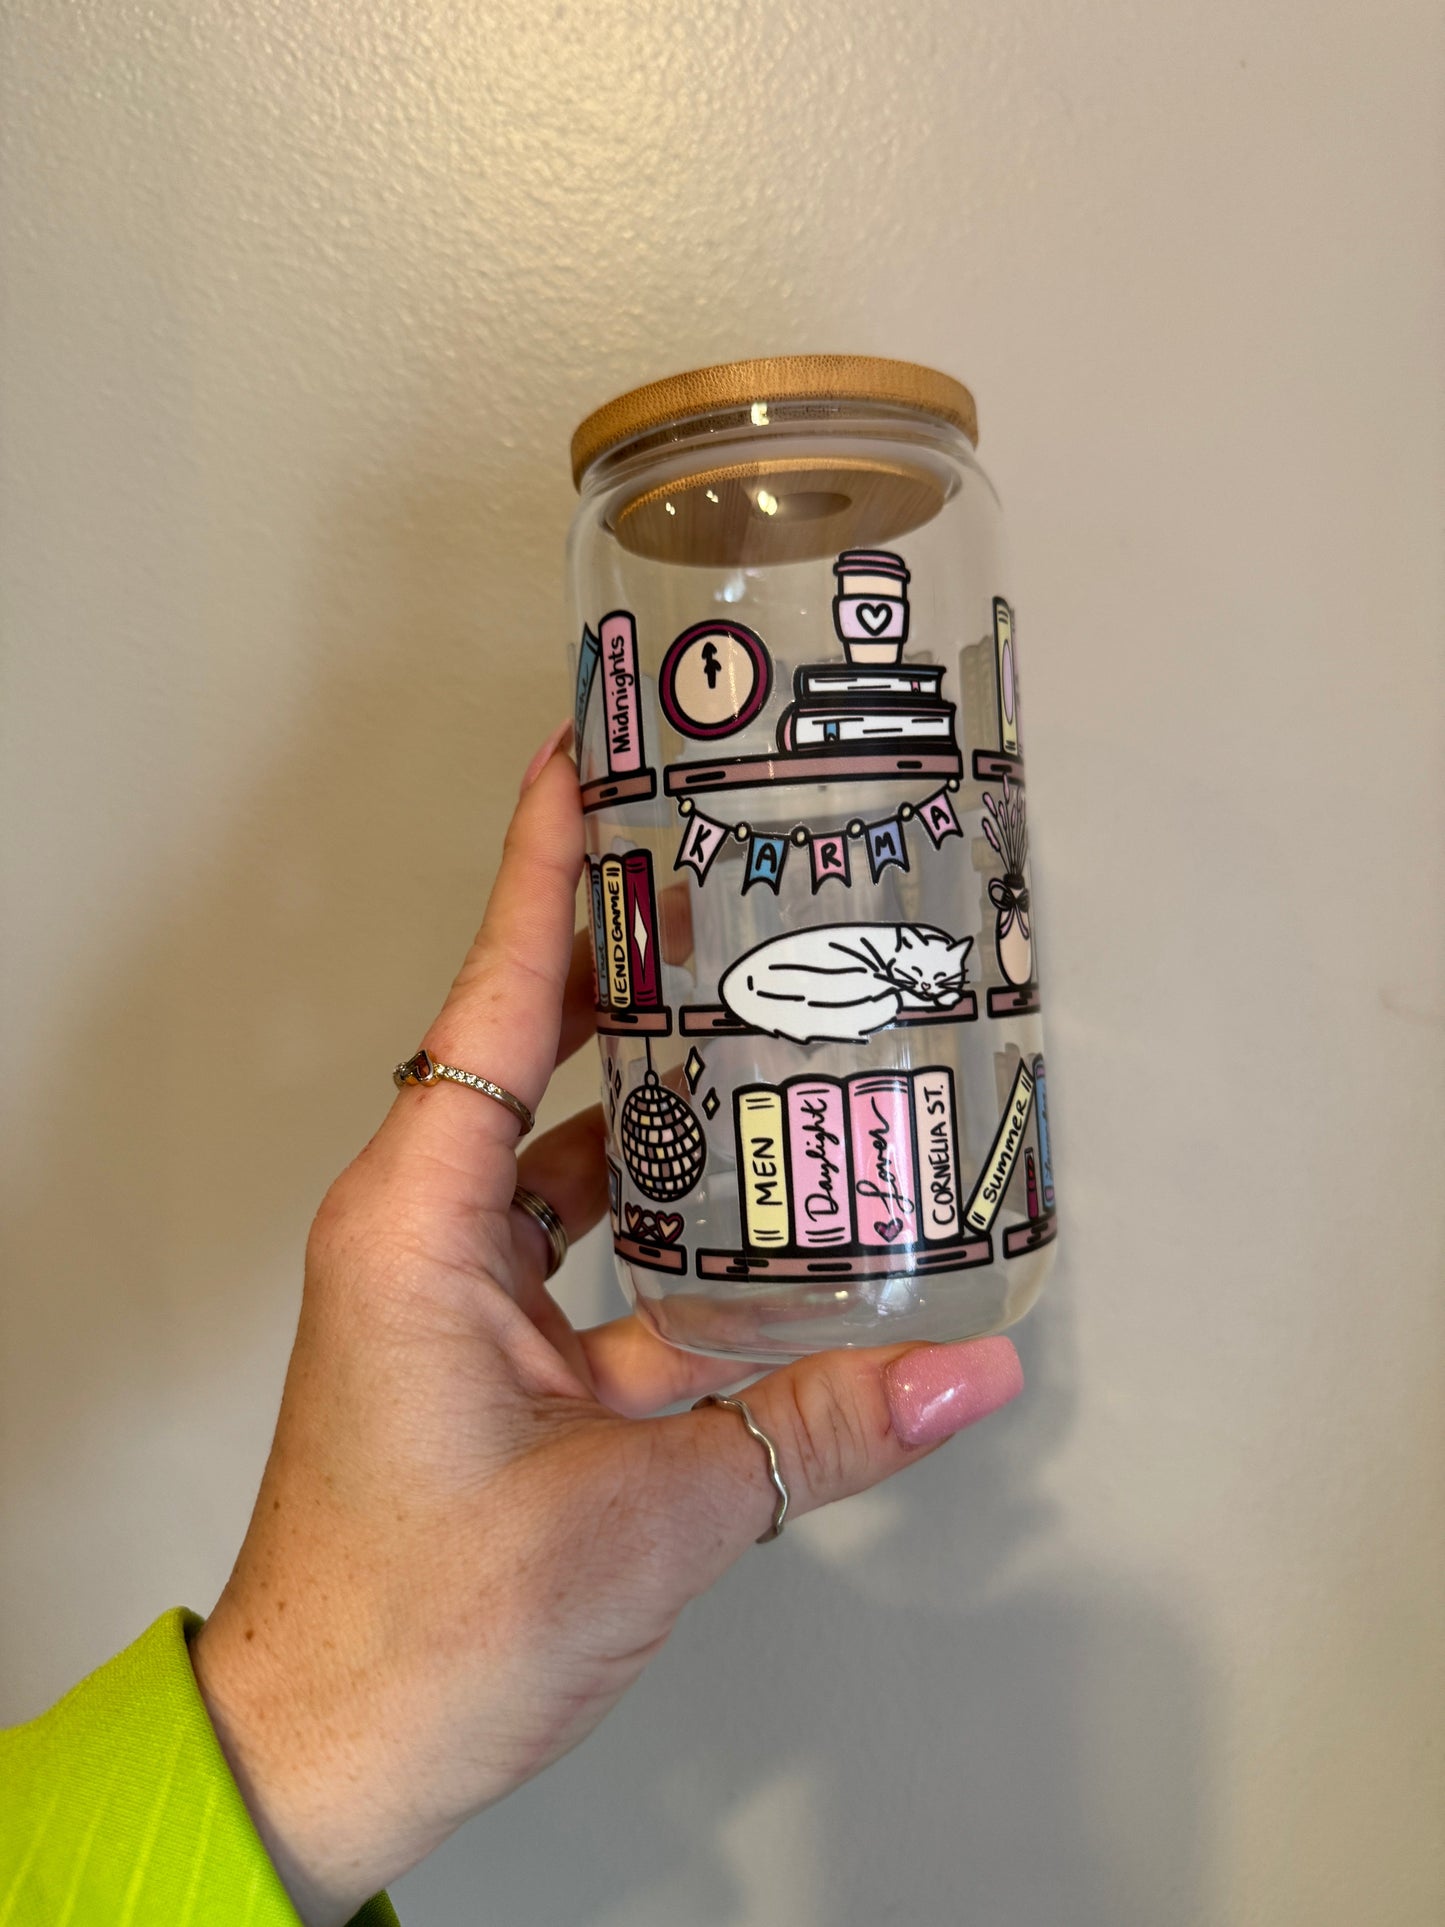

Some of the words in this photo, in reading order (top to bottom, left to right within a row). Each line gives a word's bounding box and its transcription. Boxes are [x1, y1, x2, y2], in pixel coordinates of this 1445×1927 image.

[610, 635, 634, 754] Midnights
[688, 804, 951, 874] KARMA
[607, 881, 627, 993] ENDGAME
[923, 1084, 946, 1116] ST.
[750, 1137, 783, 1206] MEN
[800, 1097, 840, 1222] Daylight
[855, 1096, 915, 1214] Lover
[928, 1121, 955, 1226] CORNELIA
